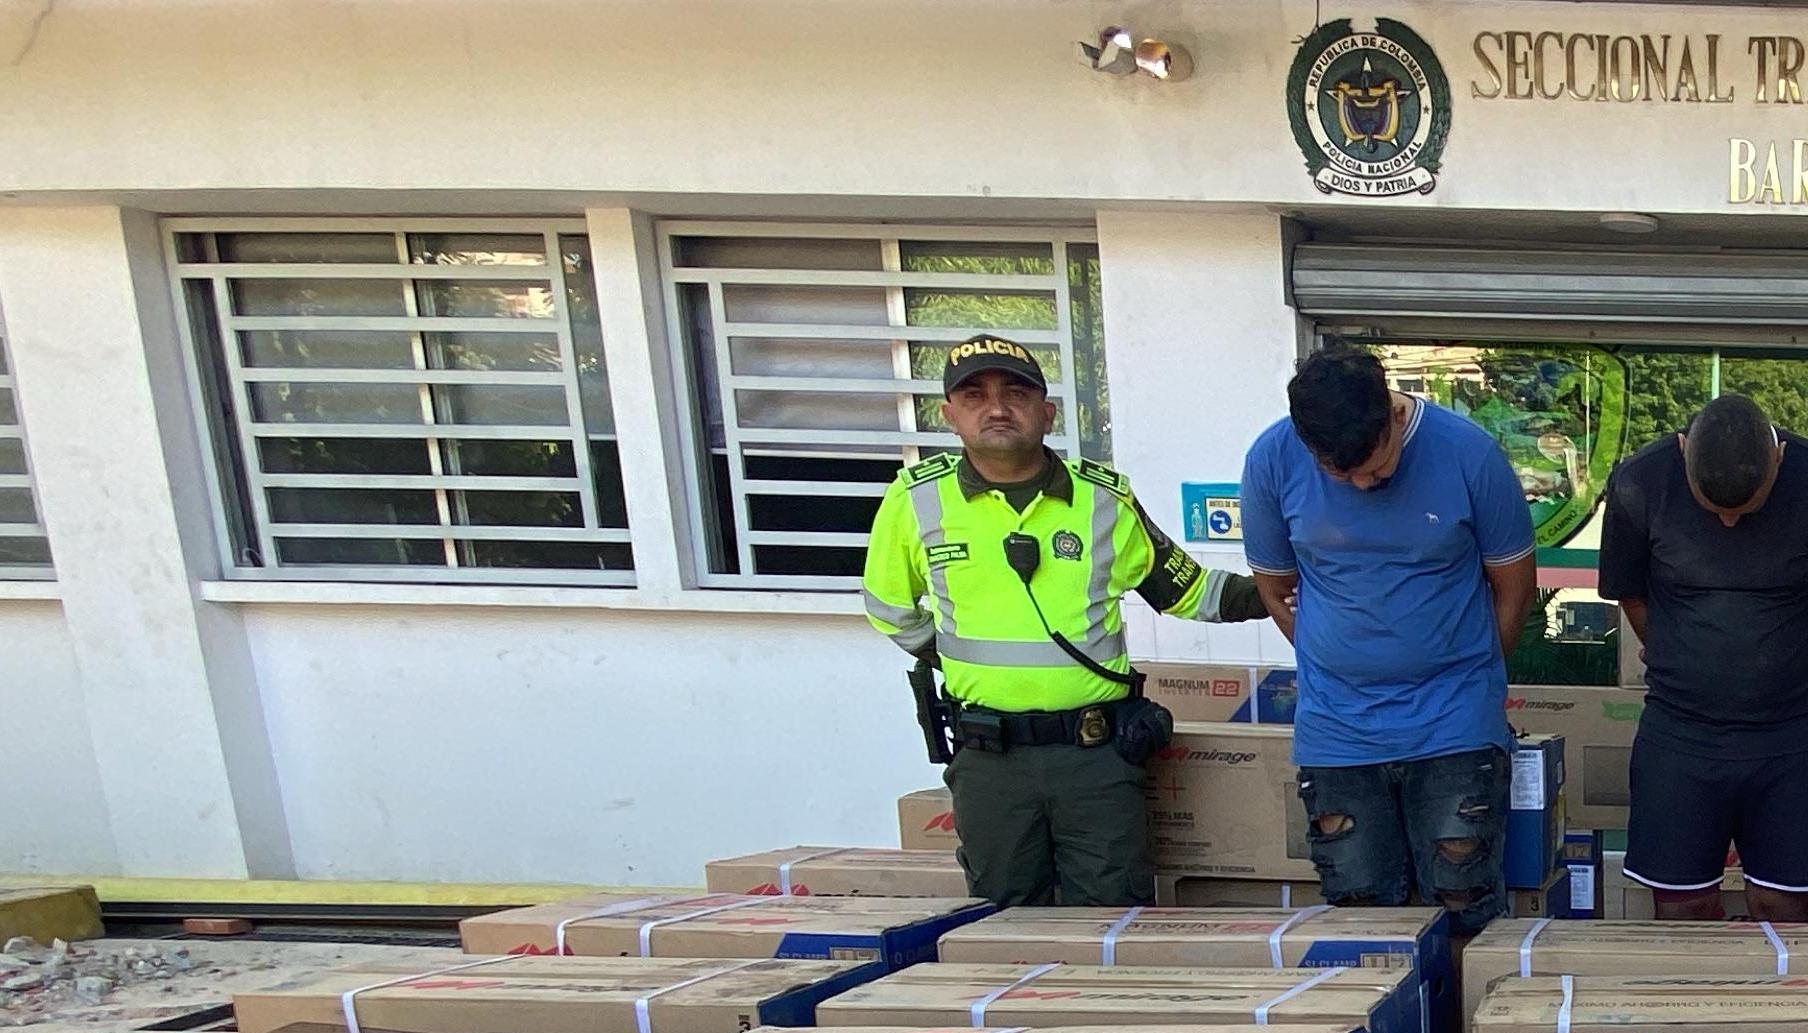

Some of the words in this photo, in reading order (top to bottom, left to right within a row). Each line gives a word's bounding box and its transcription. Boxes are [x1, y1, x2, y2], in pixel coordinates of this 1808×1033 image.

[1308, 37, 1359, 88] REPUBLICA
[1361, 36, 1377, 48] DE
[1379, 39, 1427, 92] COLOMBIA
[1471, 31, 1734, 103] SECCIONAL
[1323, 142, 1362, 173] POLICIA
[1367, 141, 1422, 174] NACIONAL
[1330, 174, 1361, 192] DIOS
[1364, 181, 1373, 193] Y
[1376, 175, 1417, 193] PATRIA
[950, 339, 1031, 367] POLICIA
[1158, 678, 1209, 690] MAGNUM
[1215, 682, 1238, 695] 22
[1524, 697, 1575, 713] mirage
[1187, 749, 1257, 765] mirage
